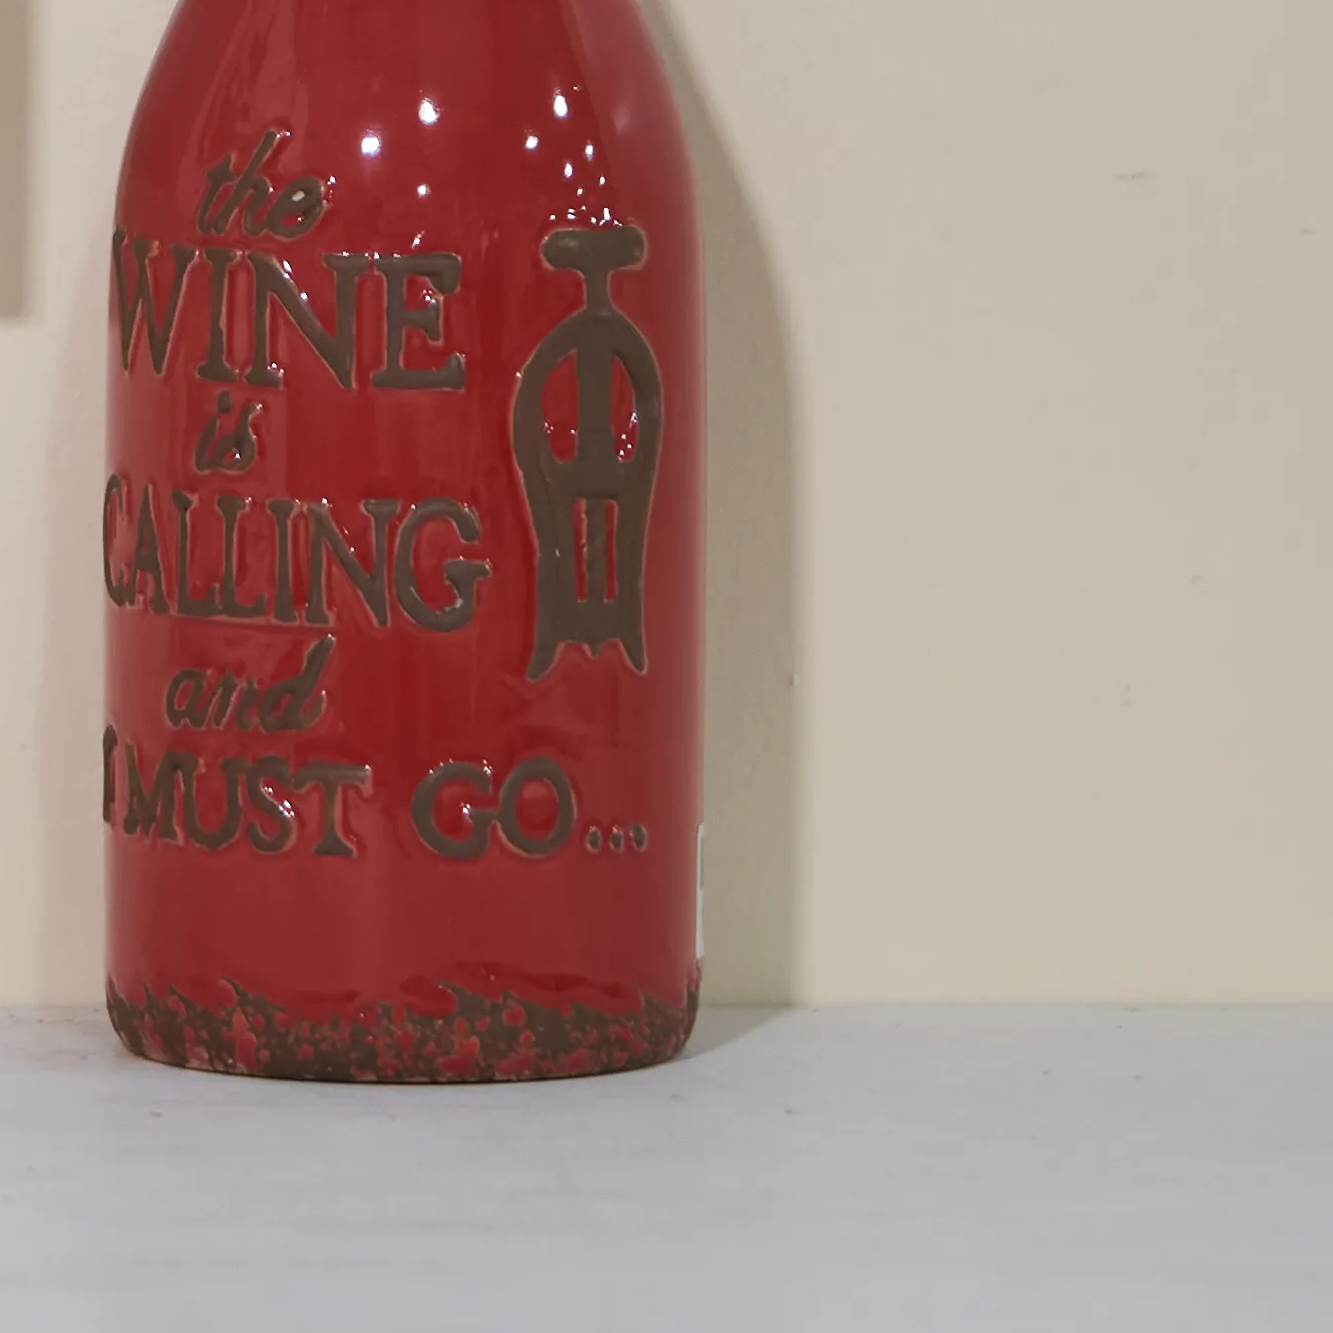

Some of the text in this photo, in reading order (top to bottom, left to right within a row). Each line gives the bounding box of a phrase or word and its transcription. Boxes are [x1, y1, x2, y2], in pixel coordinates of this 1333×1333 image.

[196, 129, 333, 238] the
[112, 226, 466, 390] WINE
[193, 390, 263, 473] is
[103, 473, 491, 631] CALLING
[165, 634, 336, 733] and
[124, 741, 372, 857] MUST
